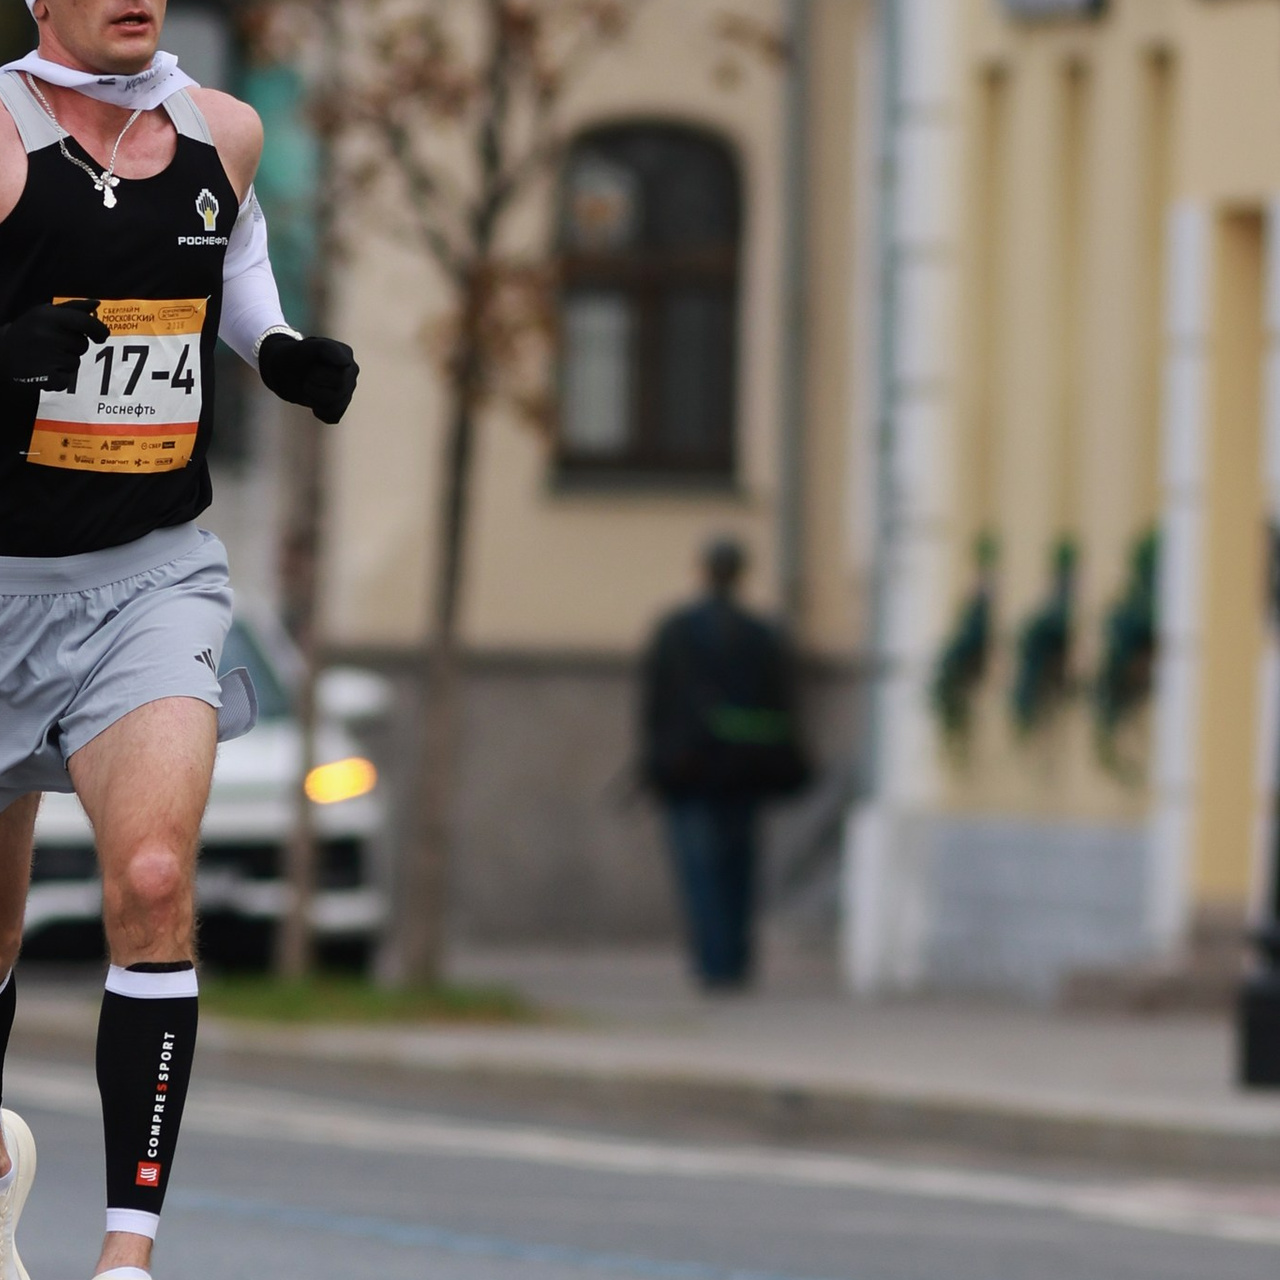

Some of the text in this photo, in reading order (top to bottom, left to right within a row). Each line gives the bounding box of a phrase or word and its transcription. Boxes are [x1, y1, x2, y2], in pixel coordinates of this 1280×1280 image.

[102, 313, 155, 323] МОСКОВСКИЙ
[96, 402, 156, 418] Роснефть
[147, 1032, 175, 1158] COMPRESSPORT
